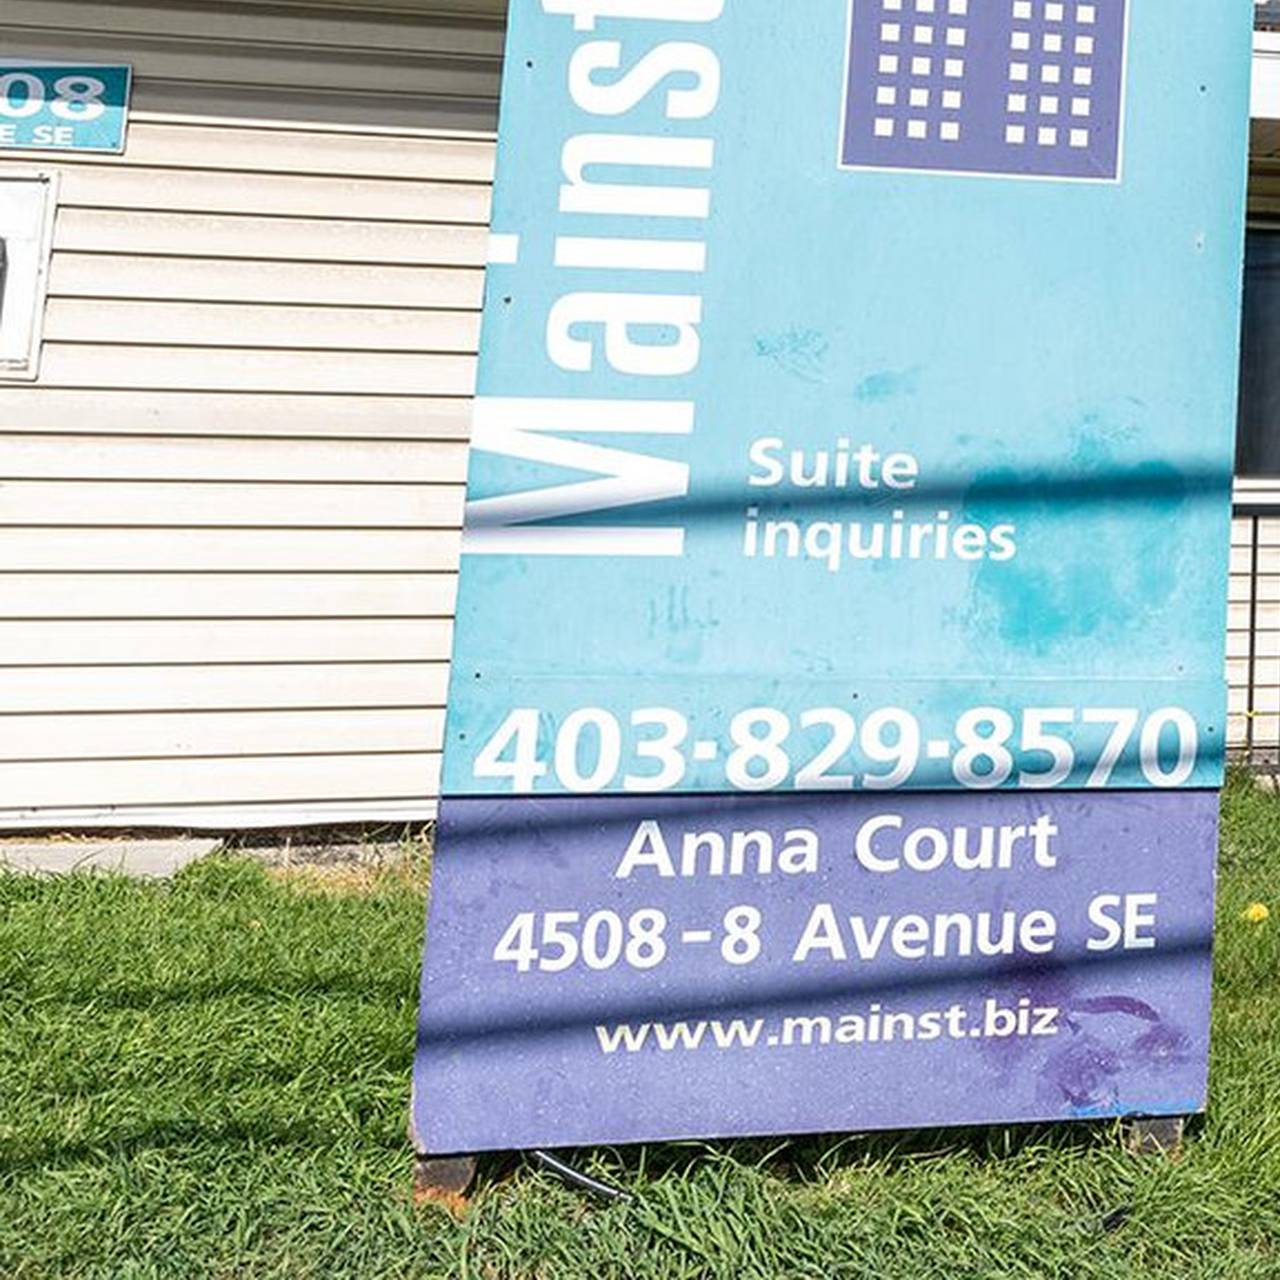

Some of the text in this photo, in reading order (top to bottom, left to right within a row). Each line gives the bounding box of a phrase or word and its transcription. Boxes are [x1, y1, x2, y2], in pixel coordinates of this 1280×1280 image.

[32, 125, 75, 146] SE
[746, 436, 919, 490] Suite
[742, 505, 1017, 572] inquiries
[472, 705, 1199, 792] 403-829-8570
[615, 812, 1058, 878] Anna Court
[792, 901, 1058, 962] Avenue
[1085, 892, 1159, 952] SE
[593, 997, 1060, 1056] www.mainst.biz
